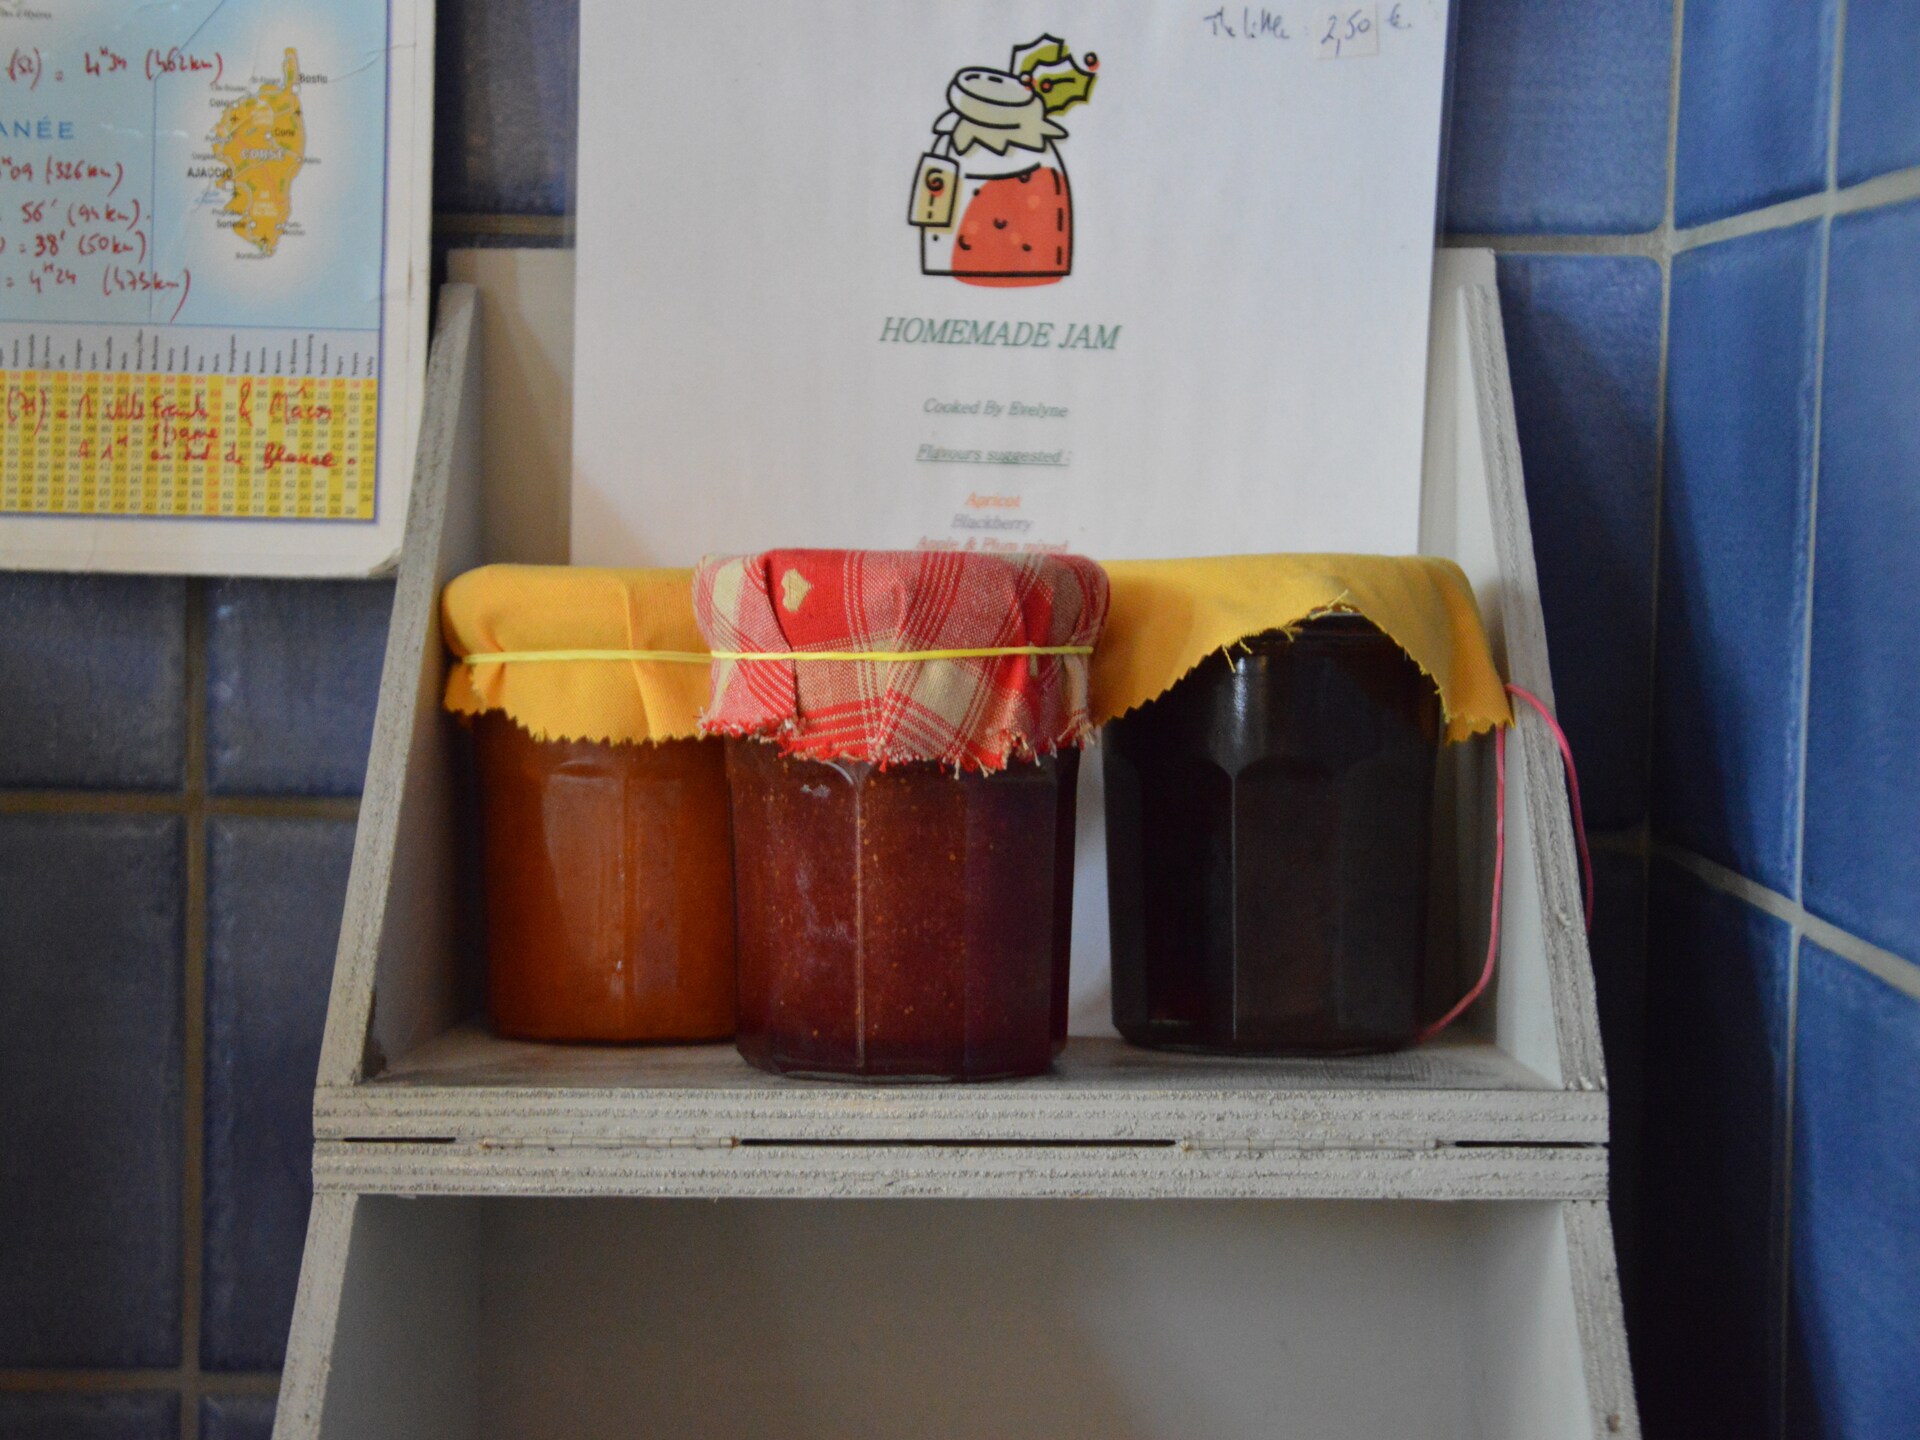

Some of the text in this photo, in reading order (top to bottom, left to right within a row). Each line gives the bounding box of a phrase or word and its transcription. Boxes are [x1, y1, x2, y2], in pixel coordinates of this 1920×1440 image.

[1320, 9, 1371, 56] 2,50
[879, 316, 1122, 350] HOMEMADE JAM
[923, 397, 1068, 419] Cooked By Evelyne
[916, 443, 982, 463] Flavours
[963, 491, 1023, 510] Apricot
[951, 513, 1035, 533] Blackberry
